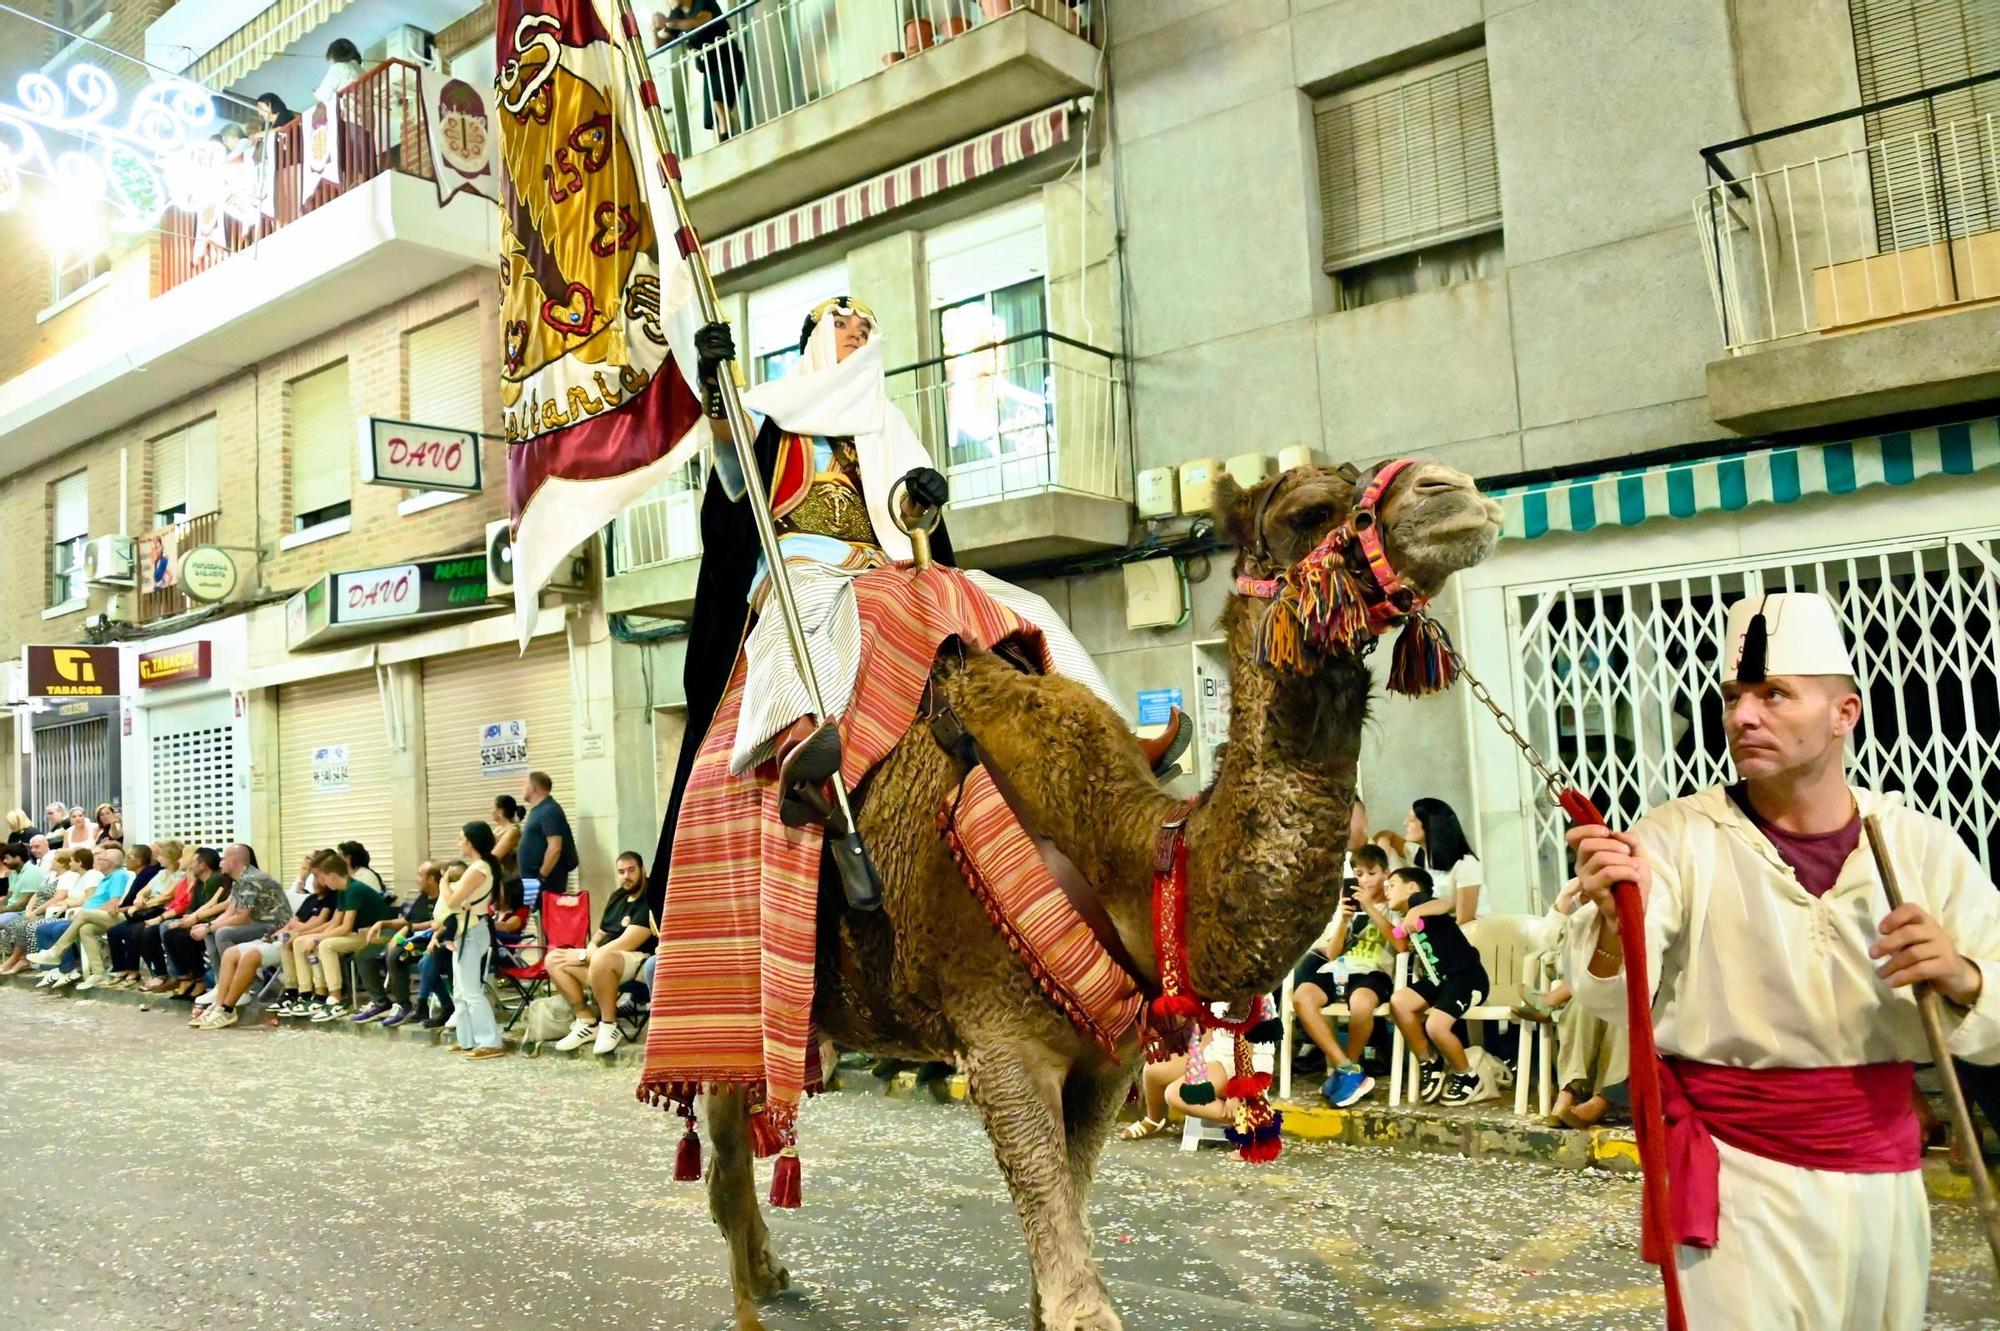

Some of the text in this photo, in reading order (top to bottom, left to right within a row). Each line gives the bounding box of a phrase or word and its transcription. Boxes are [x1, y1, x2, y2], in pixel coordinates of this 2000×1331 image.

[543, 148, 583, 204] 25
[388, 438, 465, 471] DAVÓ
[348, 569, 412, 608] DAVÓ
[152, 651, 194, 672] TABACOS
[46, 685, 103, 695] TABACOS
